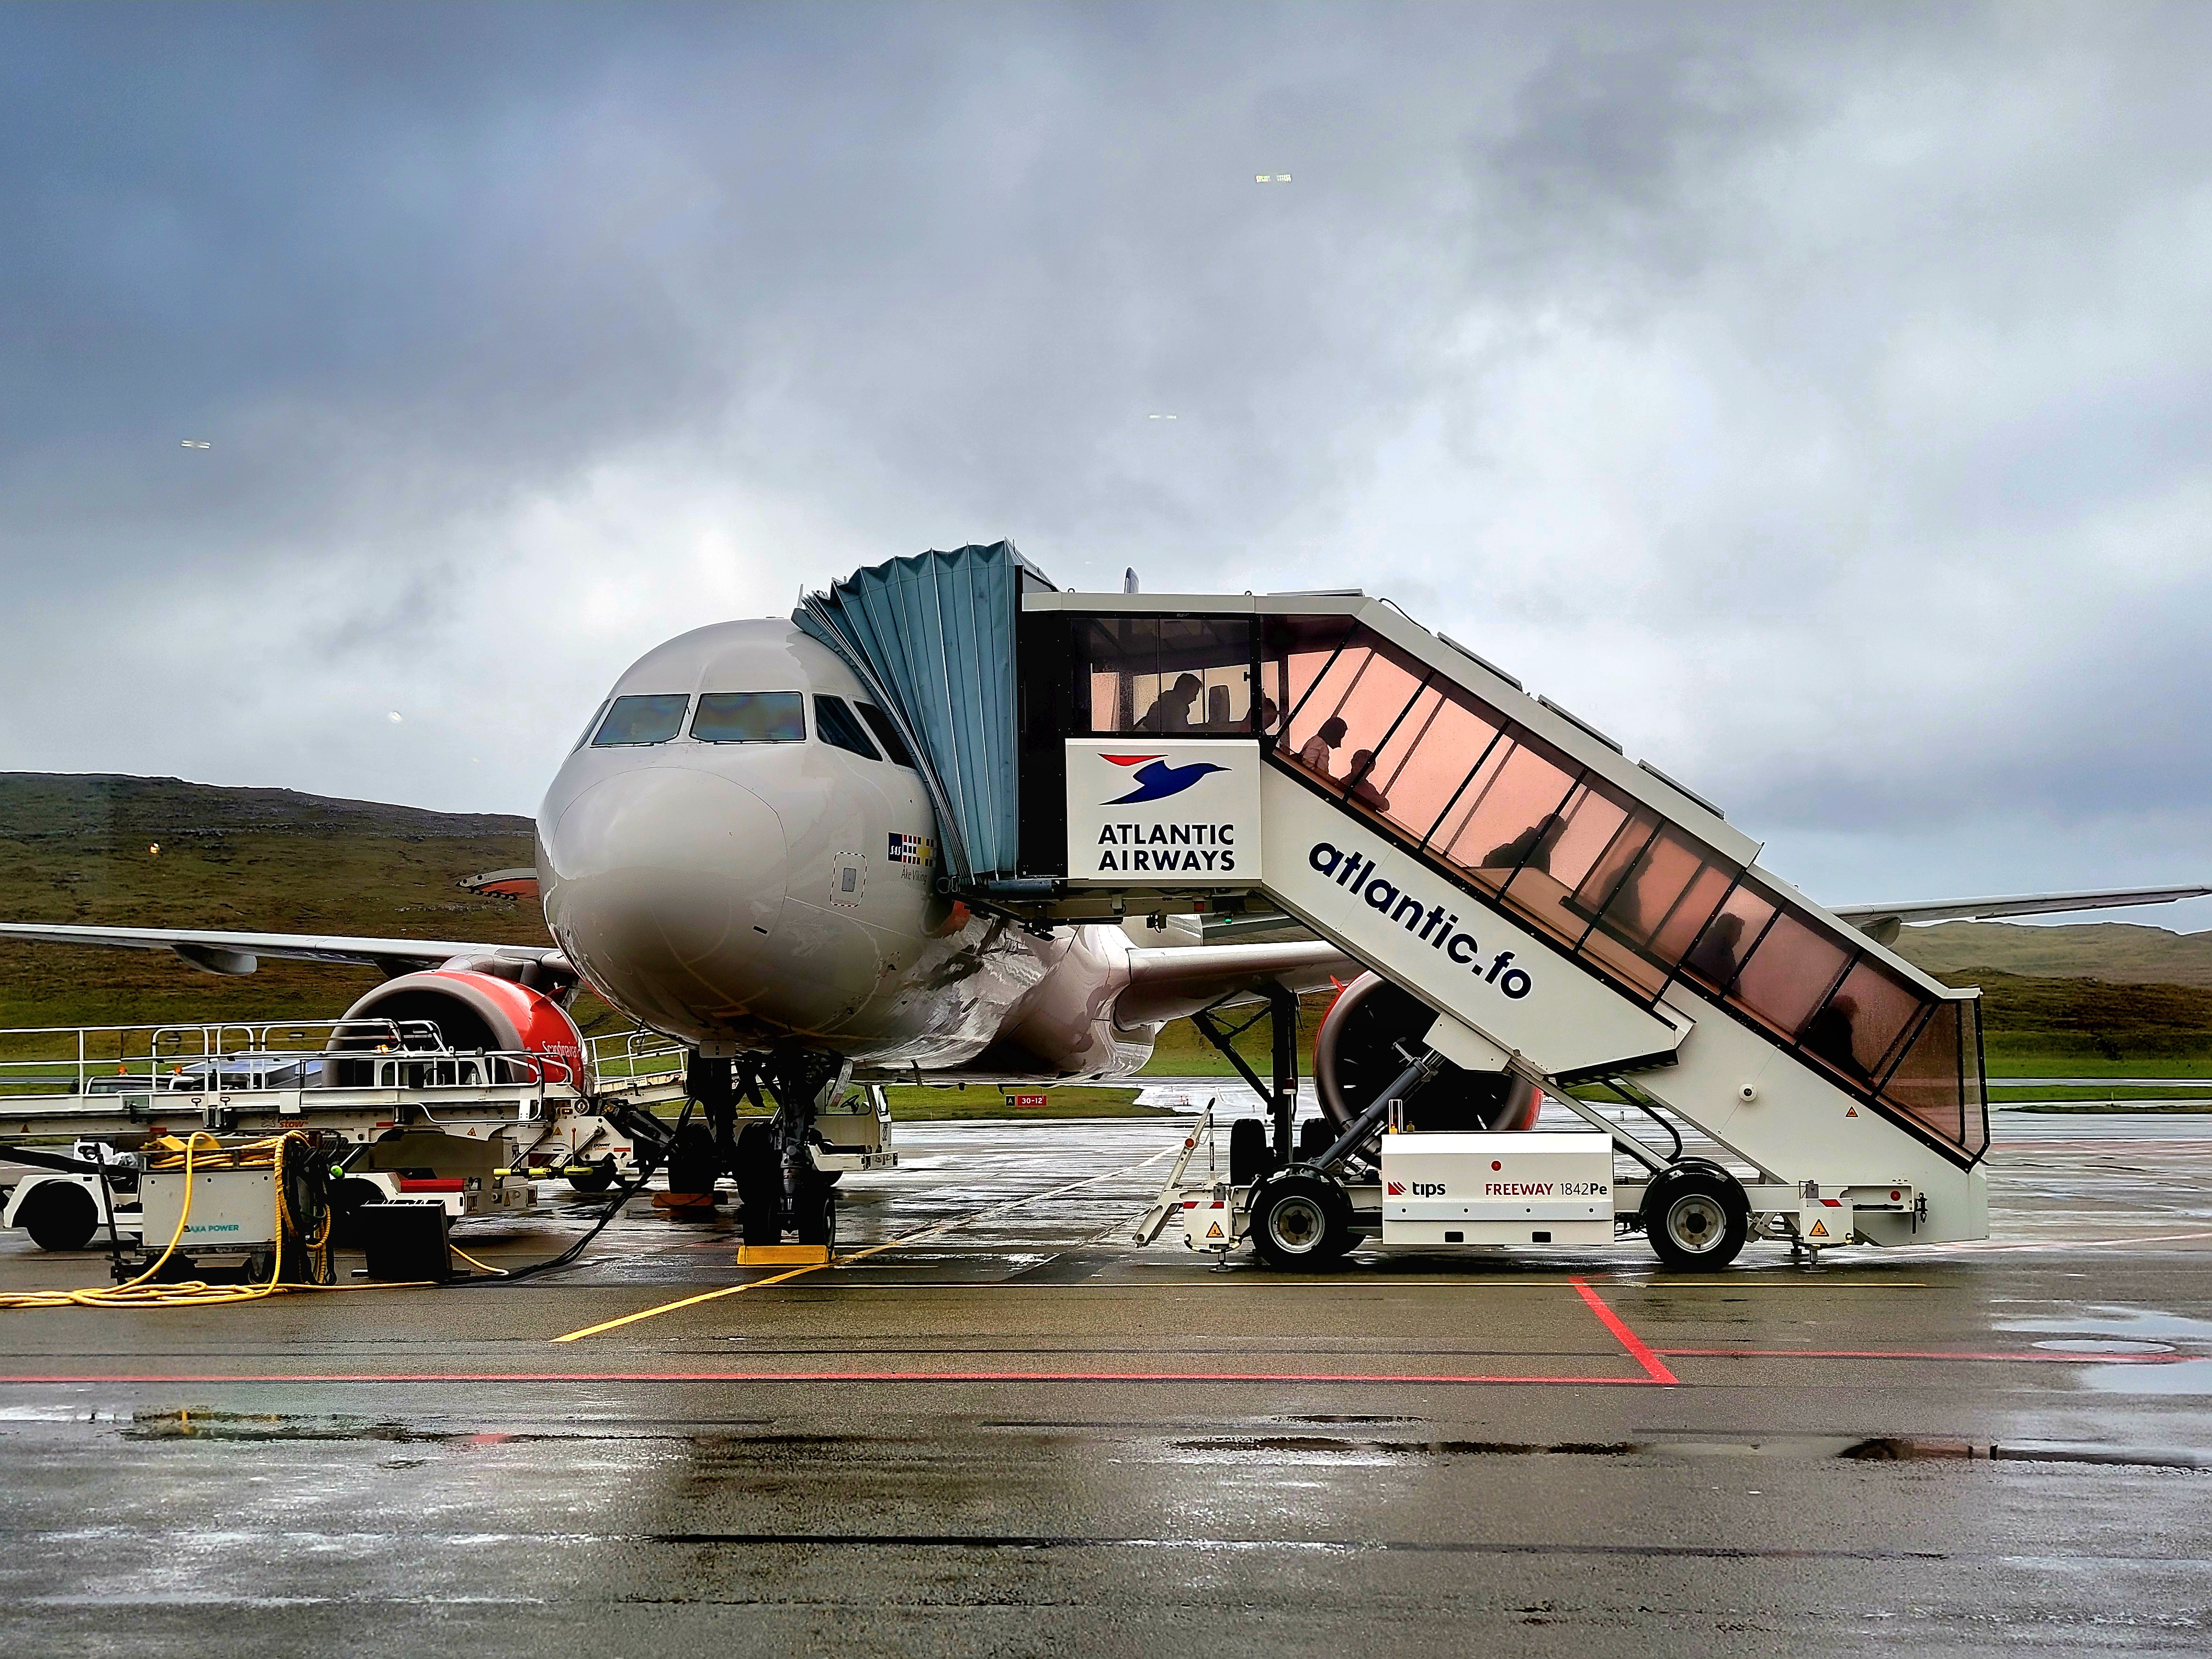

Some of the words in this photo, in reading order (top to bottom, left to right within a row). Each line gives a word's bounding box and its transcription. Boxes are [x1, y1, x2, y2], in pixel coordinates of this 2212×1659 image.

[1098, 824, 1234, 845] ATLANTIC
[889, 845, 901, 855] SAS
[1098, 850, 1235, 871] AIRWAYS
[901, 865, 911, 879] Åke
[912, 869, 927, 885] Viking
[1309, 843, 1531, 999] atlantic.fo
[278, 1113, 312, 1123] power
[1412, 1181, 1446, 1198] tips
[1485, 1183, 1554, 1195] FREEWAY
[1560, 1183, 1607, 1195] 1842Pe
